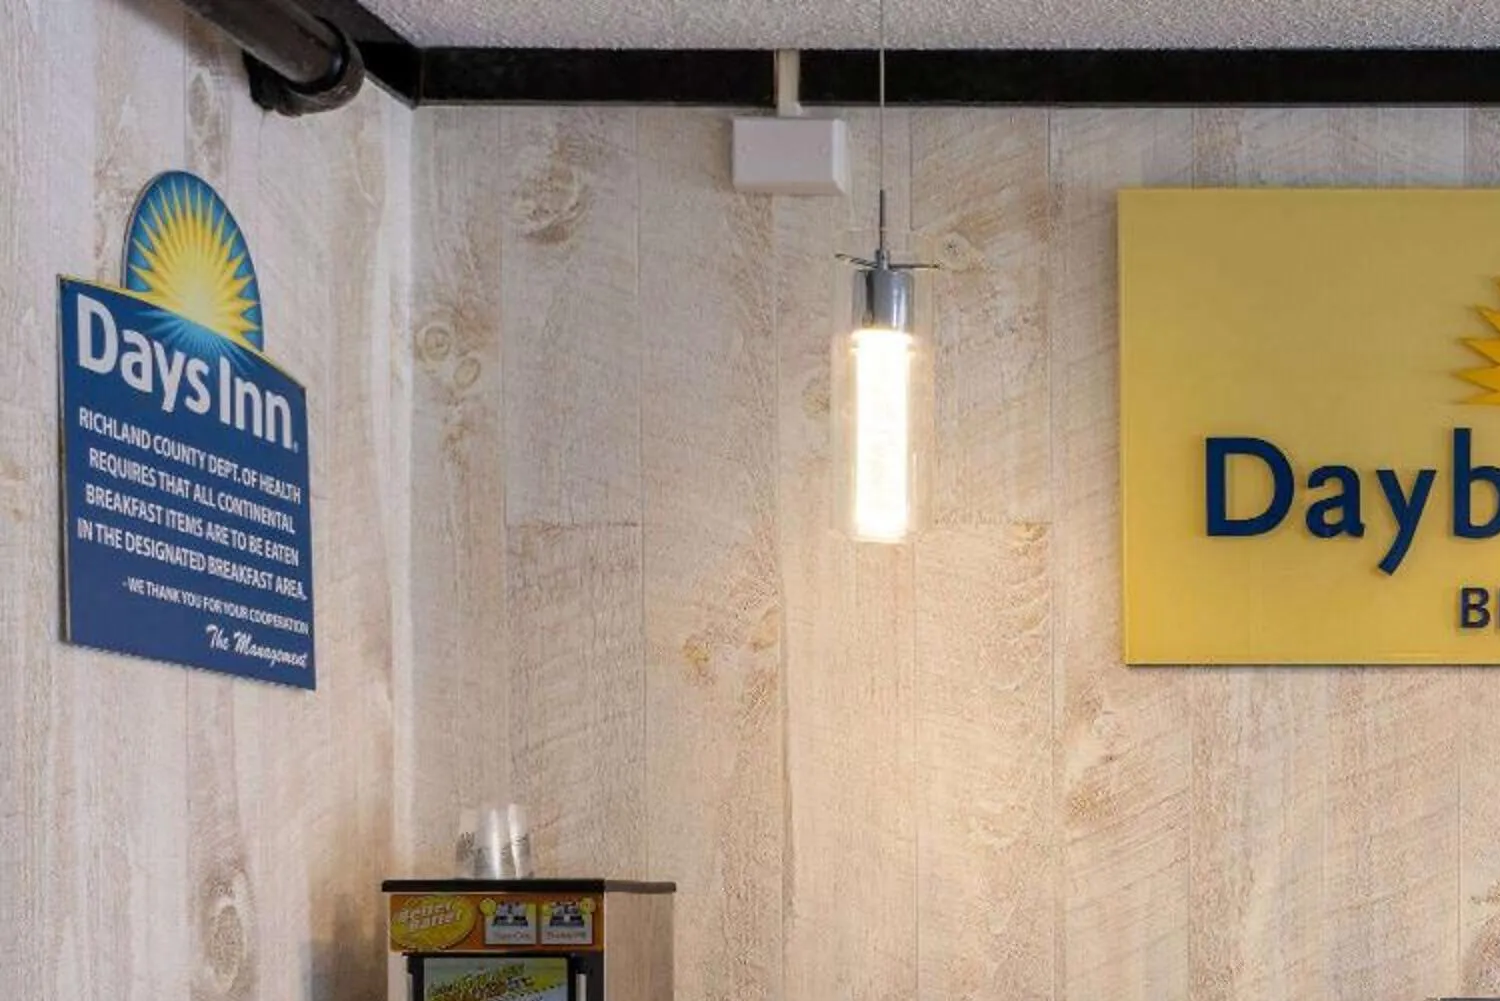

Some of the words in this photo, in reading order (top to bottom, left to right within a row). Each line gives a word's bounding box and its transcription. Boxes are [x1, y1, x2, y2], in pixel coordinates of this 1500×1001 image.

[78, 293, 211, 414] Days
[80, 406, 151, 449] RICHLAND
[153, 435, 206, 471] COUNTY
[208, 453, 241, 482] DEPT.
[242, 467, 258, 488] OF
[260, 473, 301, 504] HEALTH
[89, 447, 157, 488] REQUIRES
[158, 471, 191, 499] THAT
[193, 483, 216, 508] ALL
[218, 491, 295, 534] CONTINENTAL
[78, 517, 93, 541] IN
[95, 523, 123, 549] THE
[124, 531, 206, 572] DESIGNATED
[208, 555, 273, 591] BREAKFAST
[85, 483, 164, 525] BREAKFAST
[165, 508, 203, 538] ITEMS
[206, 521, 229, 545] ARE
[231, 529, 247, 550] TO
[249, 535, 263, 556] BE
[265, 539, 299, 567] EATEN
[146, 580, 180, 602] THANK
[182, 589, 201, 609] YOU
[203, 596, 223, 615] FOR
[206, 624, 229, 651] The
[234, 631, 307, 669] Management
